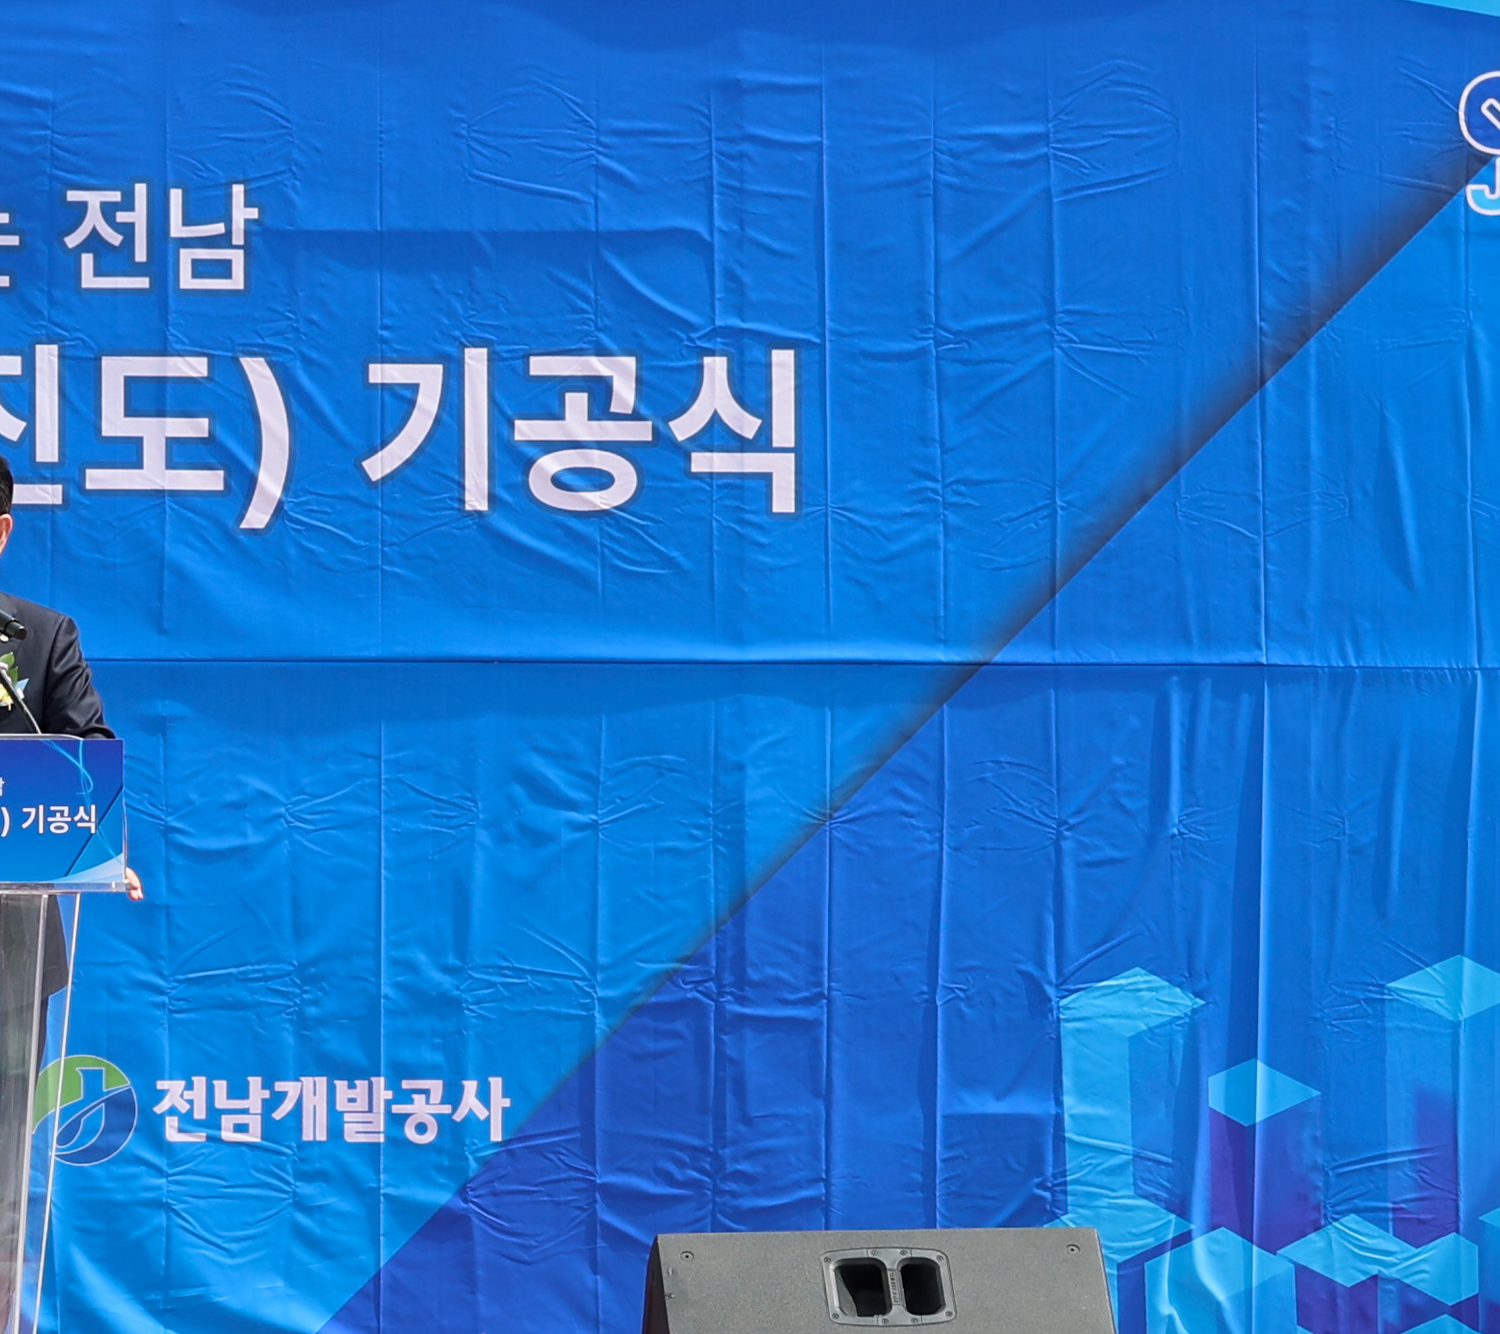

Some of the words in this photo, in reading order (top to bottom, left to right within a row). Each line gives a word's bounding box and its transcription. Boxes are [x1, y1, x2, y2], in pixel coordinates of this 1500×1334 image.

[62, 182, 260, 291] 전남
[360, 346, 797, 514] 기공식
[21, 803, 97, 835] 기공식
[152, 1075, 511, 1144] 전남개발공사
